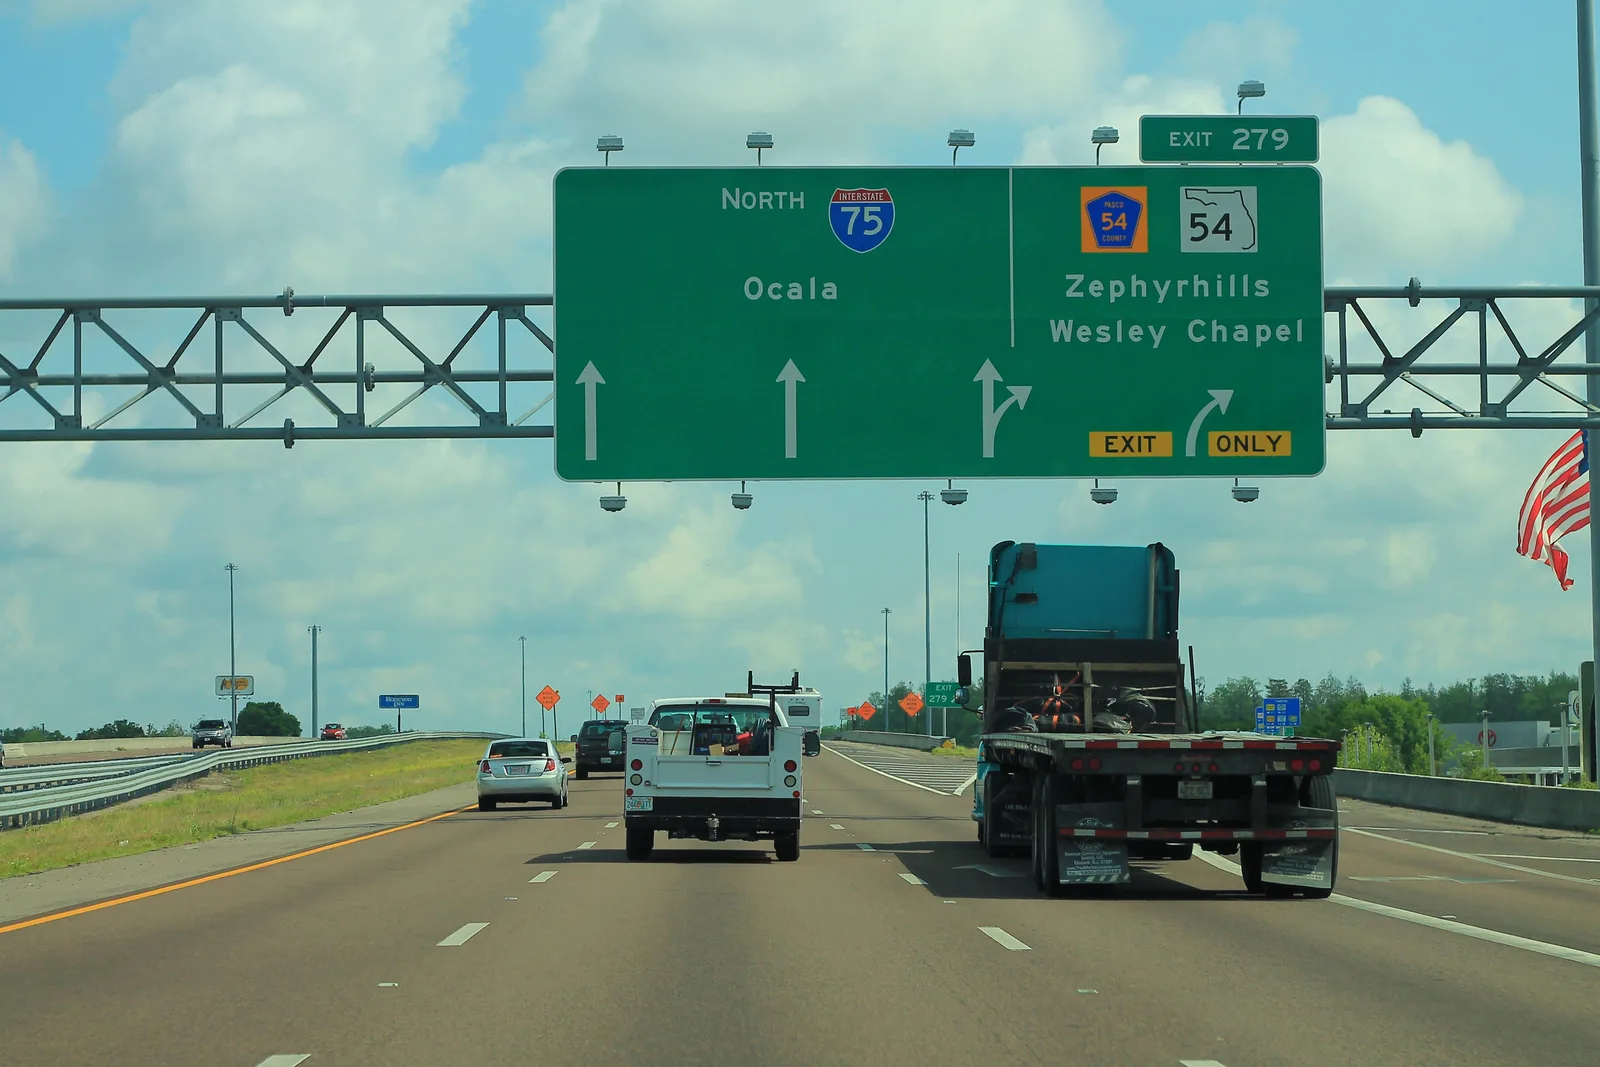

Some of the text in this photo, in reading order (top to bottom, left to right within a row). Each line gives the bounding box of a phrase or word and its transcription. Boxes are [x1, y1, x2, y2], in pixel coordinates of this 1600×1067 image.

[1169, 128, 1289, 151] EXIT 279
[721, 187, 805, 210] NORTH
[839, 192, 884, 201] INTERSTATE
[1104, 201, 1124, 209] PASCO
[840, 206, 883, 236] 75
[1101, 212, 1128, 231] 54
[1189, 212, 1233, 242] 54
[1102, 234, 1127, 242] COUNTY
[743, 276, 838, 301] Ocala
[1065, 273, 1270, 304] Zephyrhills
[1049, 318, 1303, 349] Wesley Chapel
[1104, 434, 1283, 453] EXIT ONLY
[929, 695, 948, 703] 279
